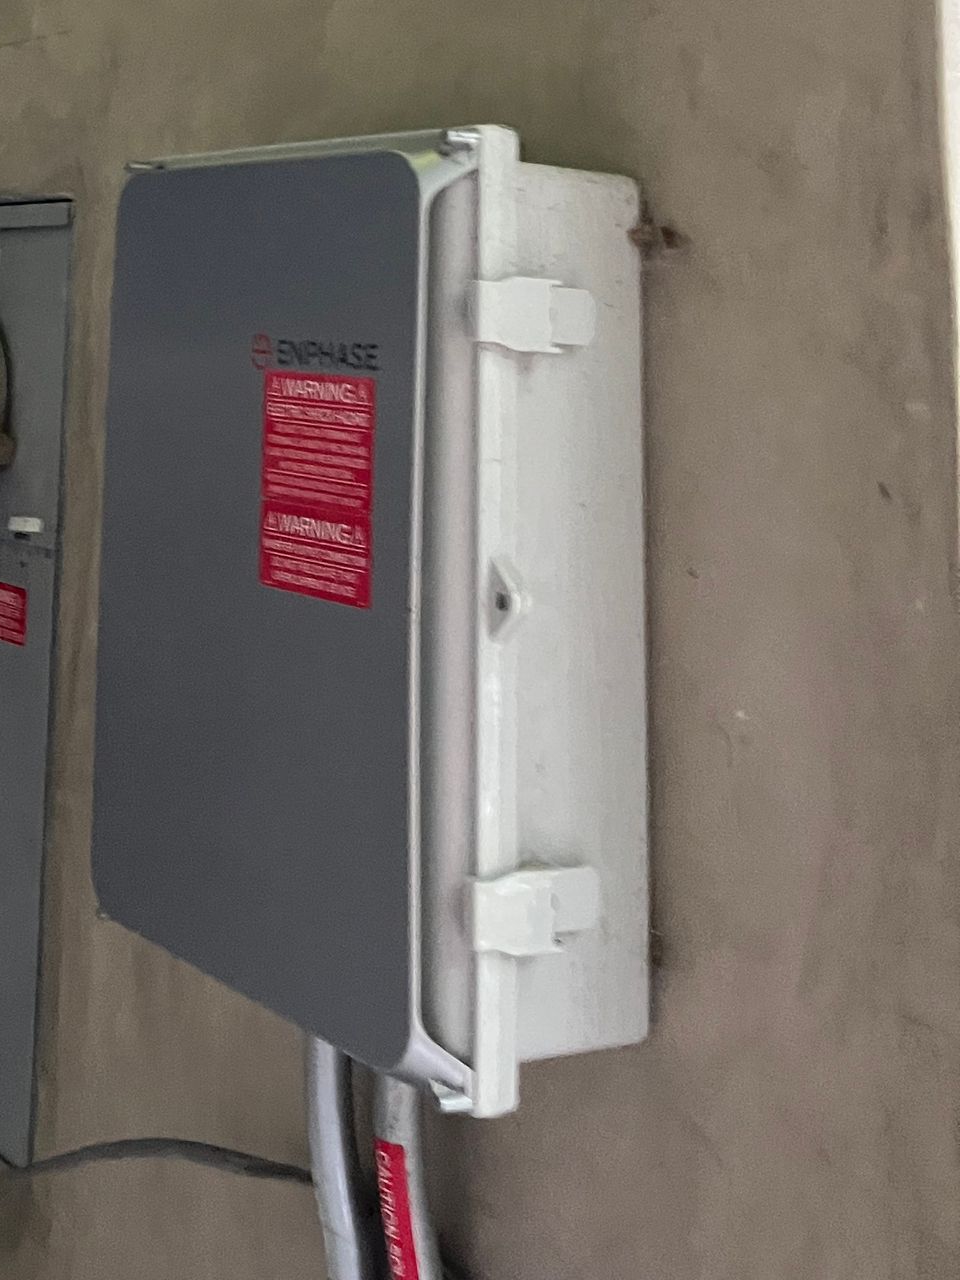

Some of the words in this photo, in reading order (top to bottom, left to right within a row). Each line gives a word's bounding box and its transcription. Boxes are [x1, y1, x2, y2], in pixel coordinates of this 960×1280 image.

[277, 340, 380, 370] ENPHASE
[280, 379, 353, 403] WARNING
[275, 517, 352, 545] WARNING
